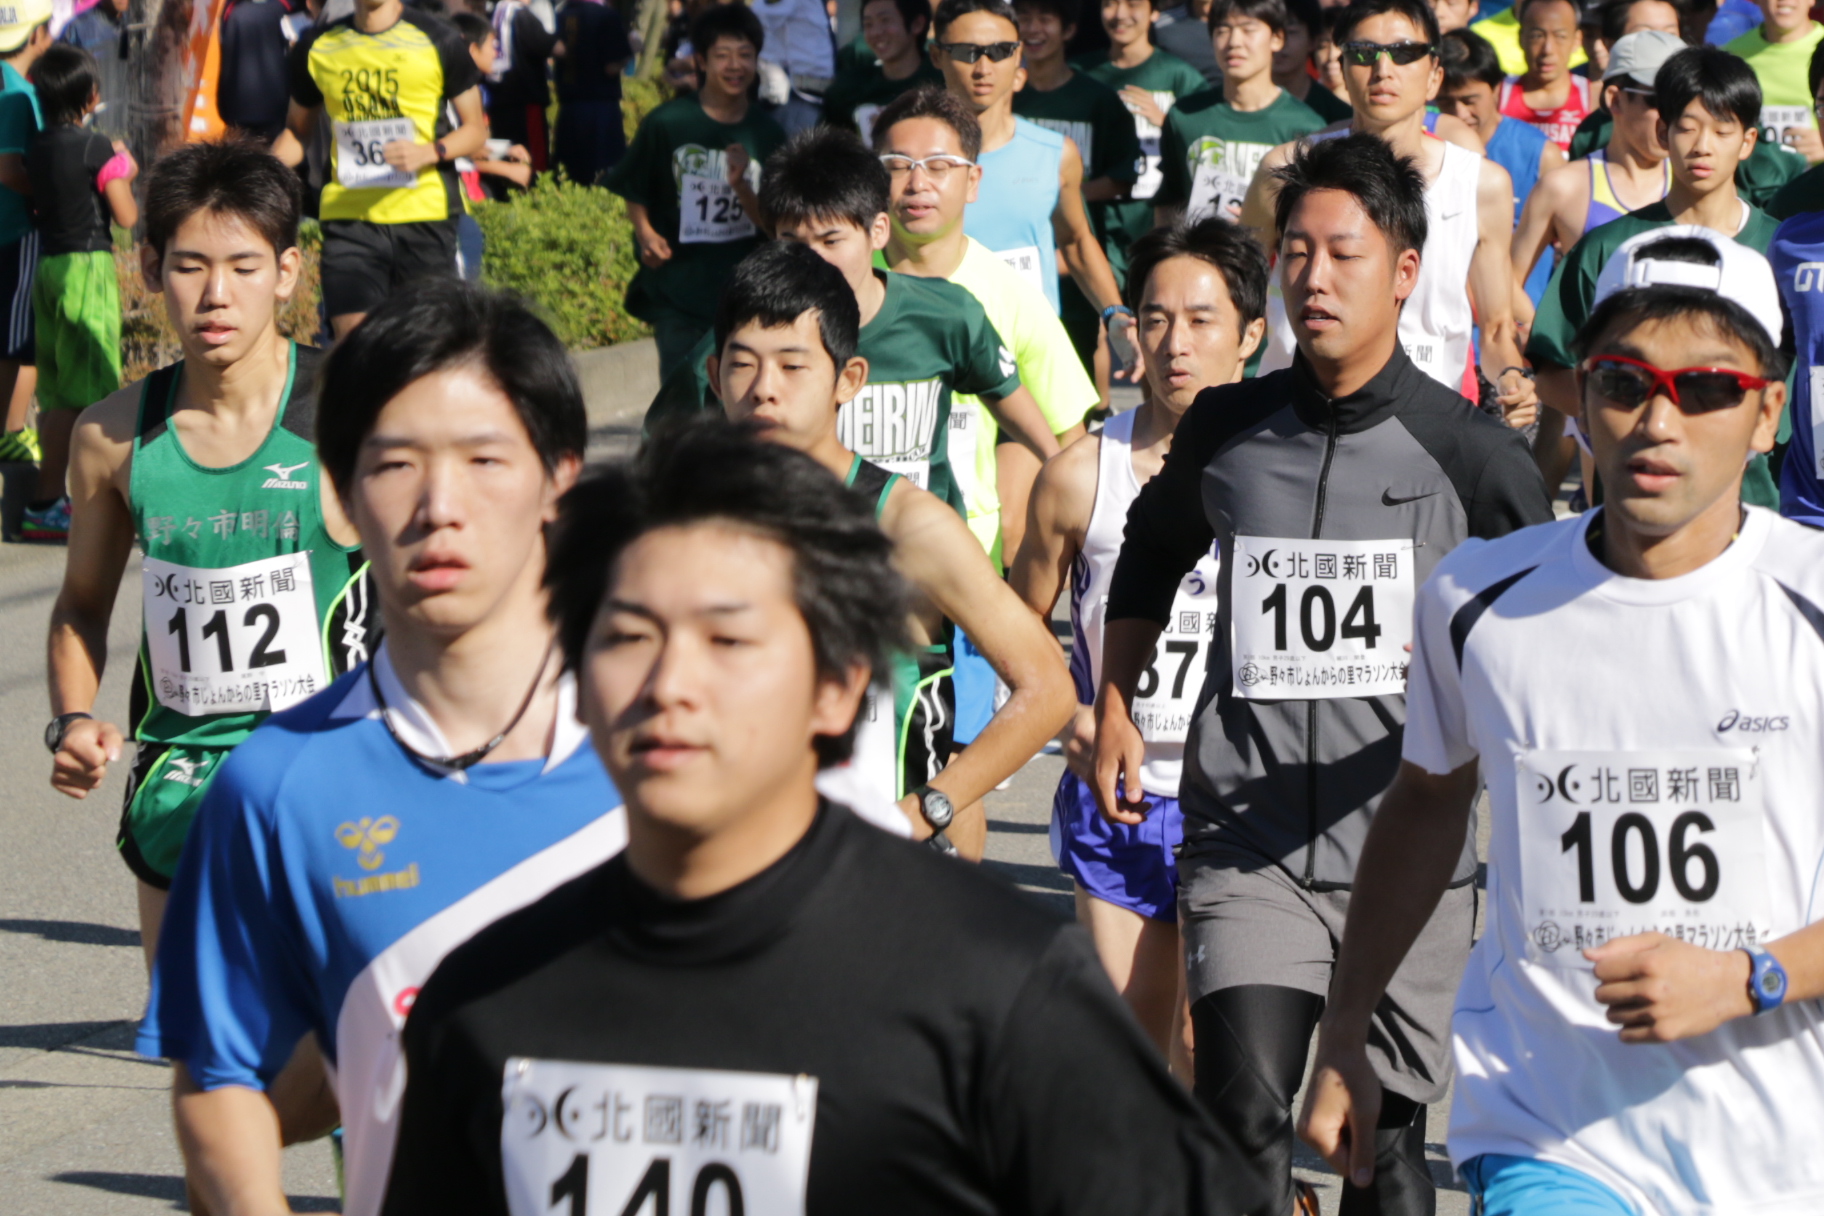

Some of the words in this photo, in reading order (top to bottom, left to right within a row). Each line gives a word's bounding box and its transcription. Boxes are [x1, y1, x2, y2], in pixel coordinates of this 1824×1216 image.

[342, 69, 399, 95] 2015
[351, 138, 396, 167] 36
[695, 195, 743, 224] 125
[261, 478, 308, 489] MIZUNO
[145, 509, 299, 546] 野々市明倫
[1286, 552, 1398, 580] 北國新聞
[184, 566, 296, 605] 北國新聞
[1262, 583, 1382, 652] 104
[168, 603, 287, 673] 112
[180, 673, 315, 705] 野々市じょんからの里マラソン大会
[1269, 661, 1406, 687] 野々市じょんからの里マラソン大会
[1738, 716, 1789, 733] asics
[1591, 766, 1741, 803] 北國新聞
[1561, 810, 1720, 904] 106
[333, 862, 420, 898] hummel
[592, 1090, 782, 1155] 北國新聞
